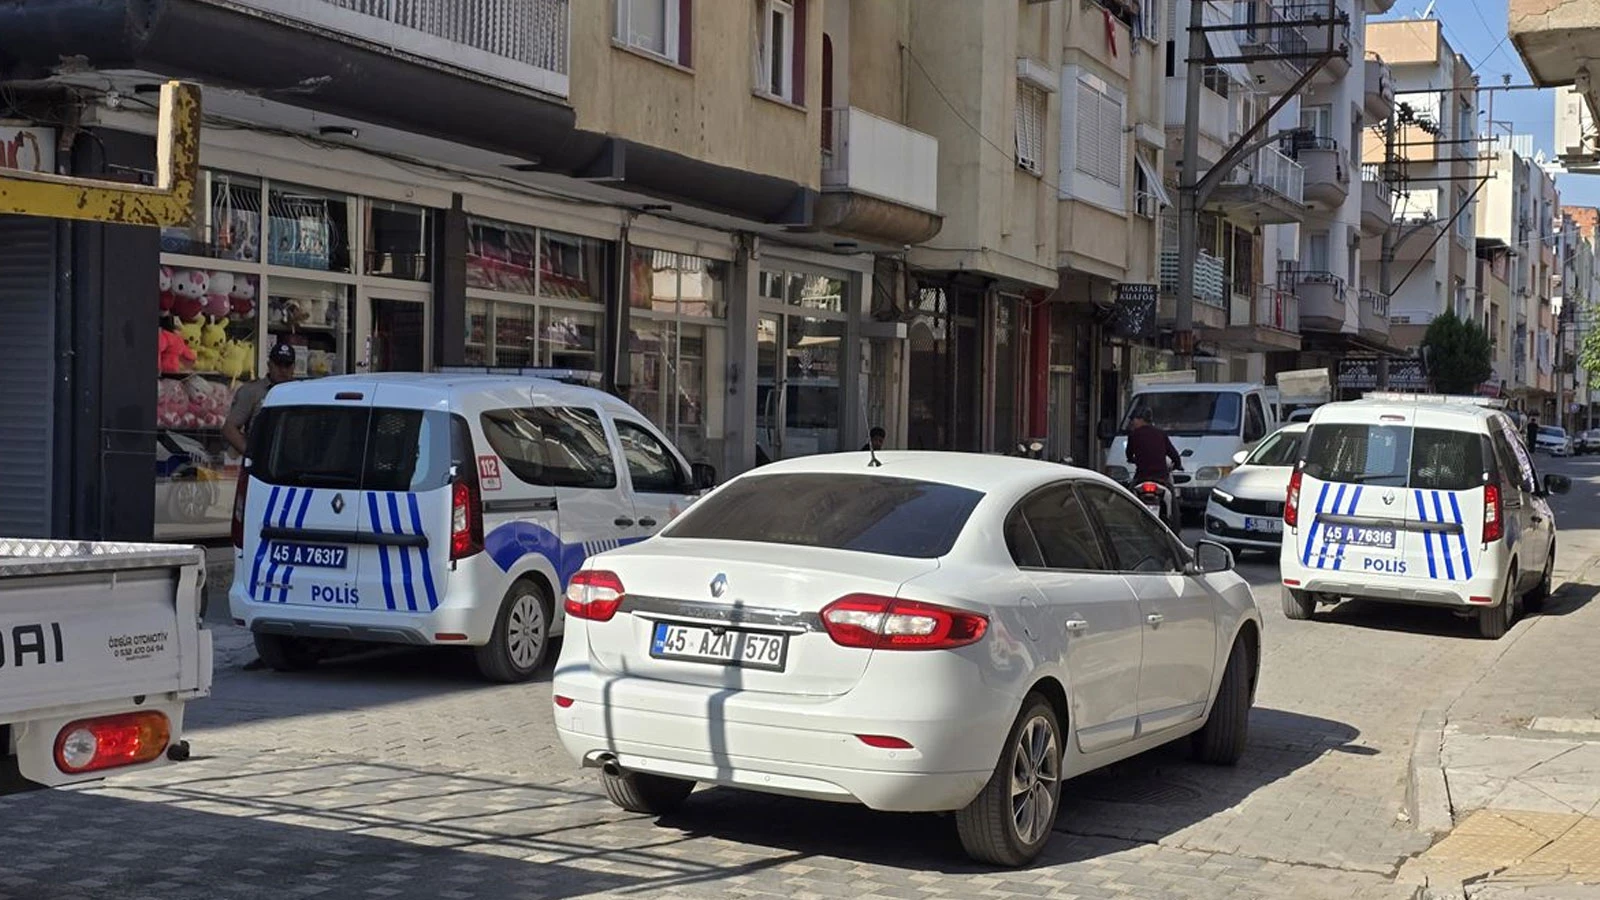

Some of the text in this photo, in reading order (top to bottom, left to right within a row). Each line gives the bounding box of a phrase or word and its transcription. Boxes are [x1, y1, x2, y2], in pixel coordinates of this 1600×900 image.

[480, 459, 498, 476] 112
[1326, 526, 1342, 539] 45
[1346, 528, 1355, 541] A
[1358, 529, 1392, 544] 76316
[272, 545, 345, 565] 45 A 76317
[1364, 556, 1407, 573] POLİS
[311, 582, 359, 604] POLİS
[0, 622, 64, 669] AI
[665, 628, 687, 652] 45
[698, 631, 733, 657] AZN
[745, 636, 781, 662] 578
